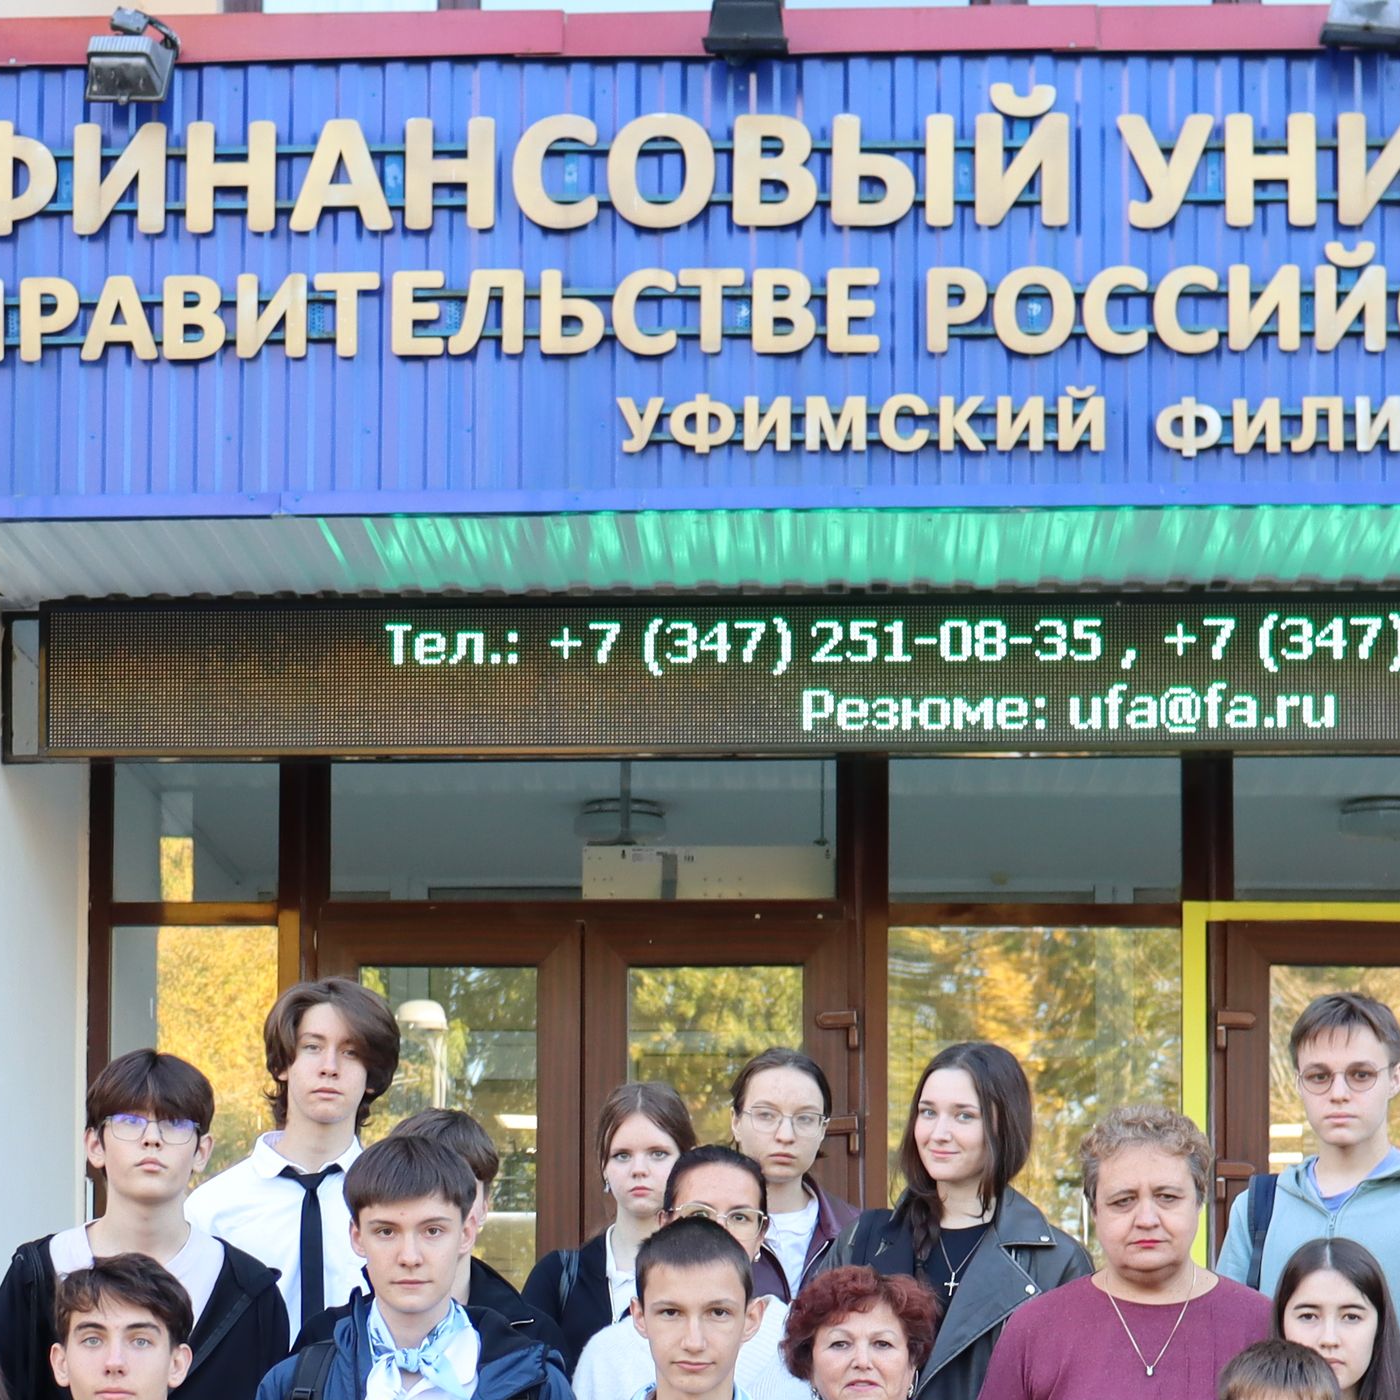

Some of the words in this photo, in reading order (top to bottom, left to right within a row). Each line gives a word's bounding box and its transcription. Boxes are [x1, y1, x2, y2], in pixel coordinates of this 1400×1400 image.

[616, 385, 1107, 455] УФИМСКИЙ
[384, 623, 520, 667] Тел.:
[549, 623, 621, 666] +7
[642, 617, 792, 674] (347)
[809, 619, 1102, 664] 251-08-35
[1163, 621, 1234, 664] +7
[802, 688, 1048, 733] Резюме:
[1068, 683, 1336, 734] ufa@fa.ru
